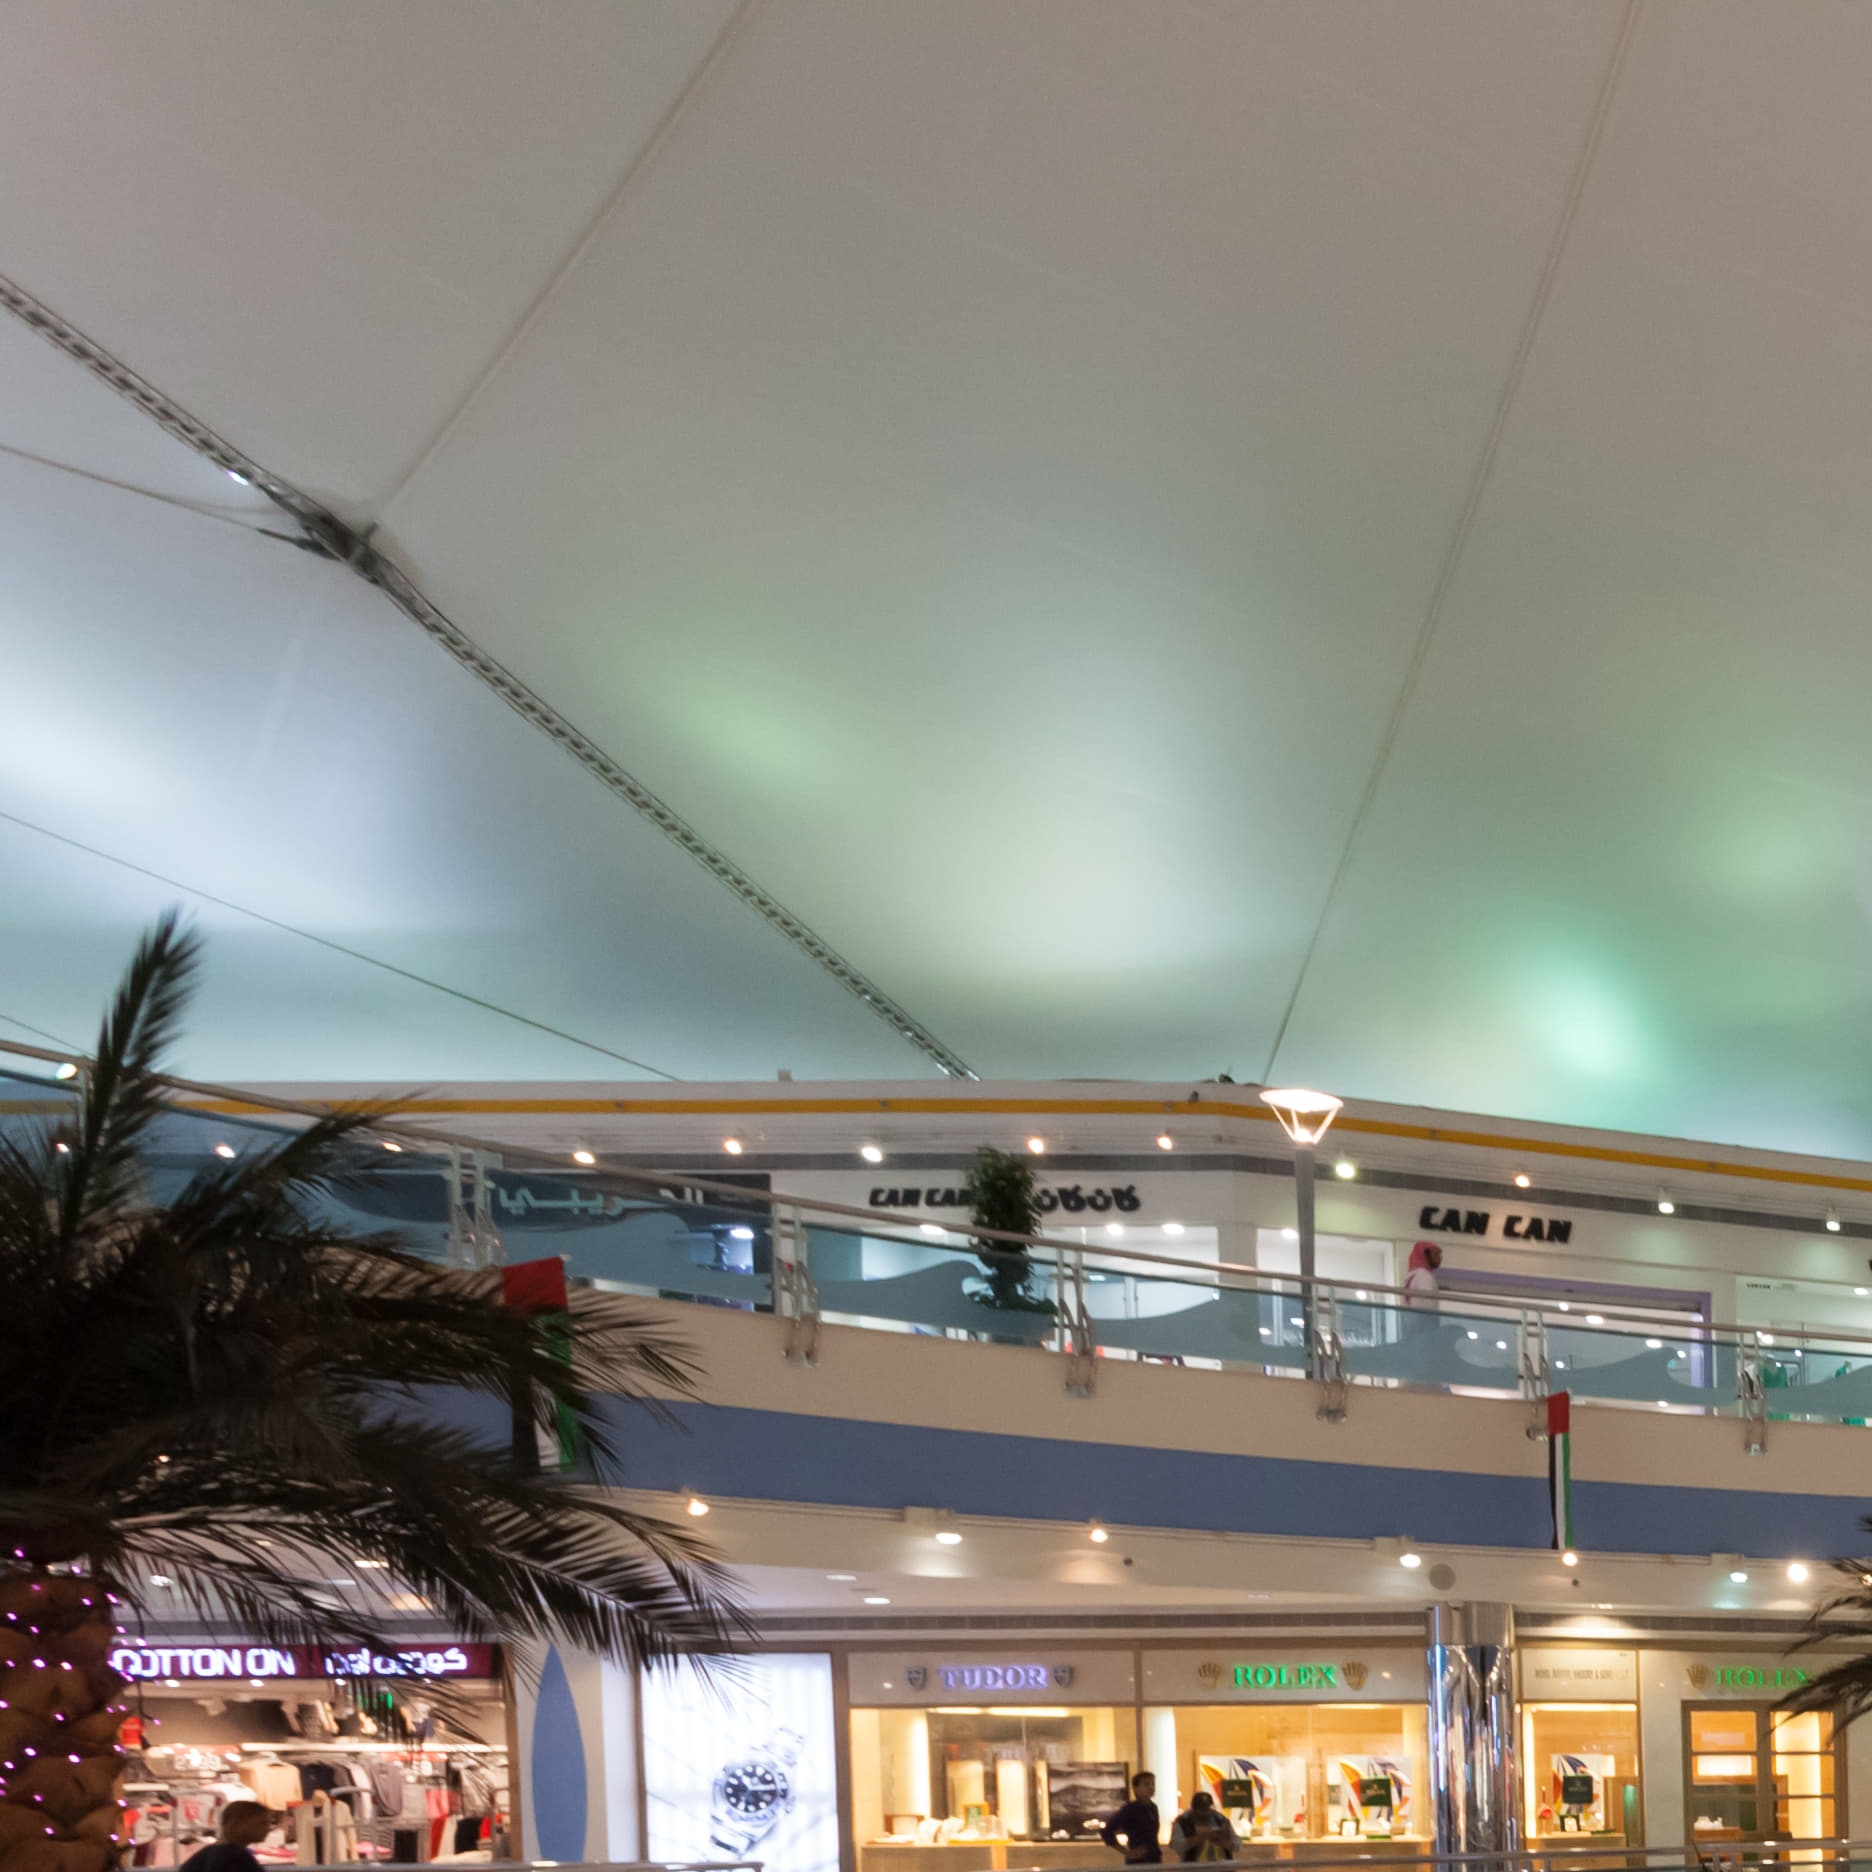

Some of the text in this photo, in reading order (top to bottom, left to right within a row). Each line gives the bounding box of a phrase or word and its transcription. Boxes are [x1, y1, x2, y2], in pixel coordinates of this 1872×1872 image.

[869, 1187, 920, 1207] CAN
[1420, 1206, 1573, 1244] CAN CAN
[246, 1648, 296, 1678] ON
[938, 1664, 1049, 1690] TUDOR
[1233, 1664, 1338, 1690] ROLEX
